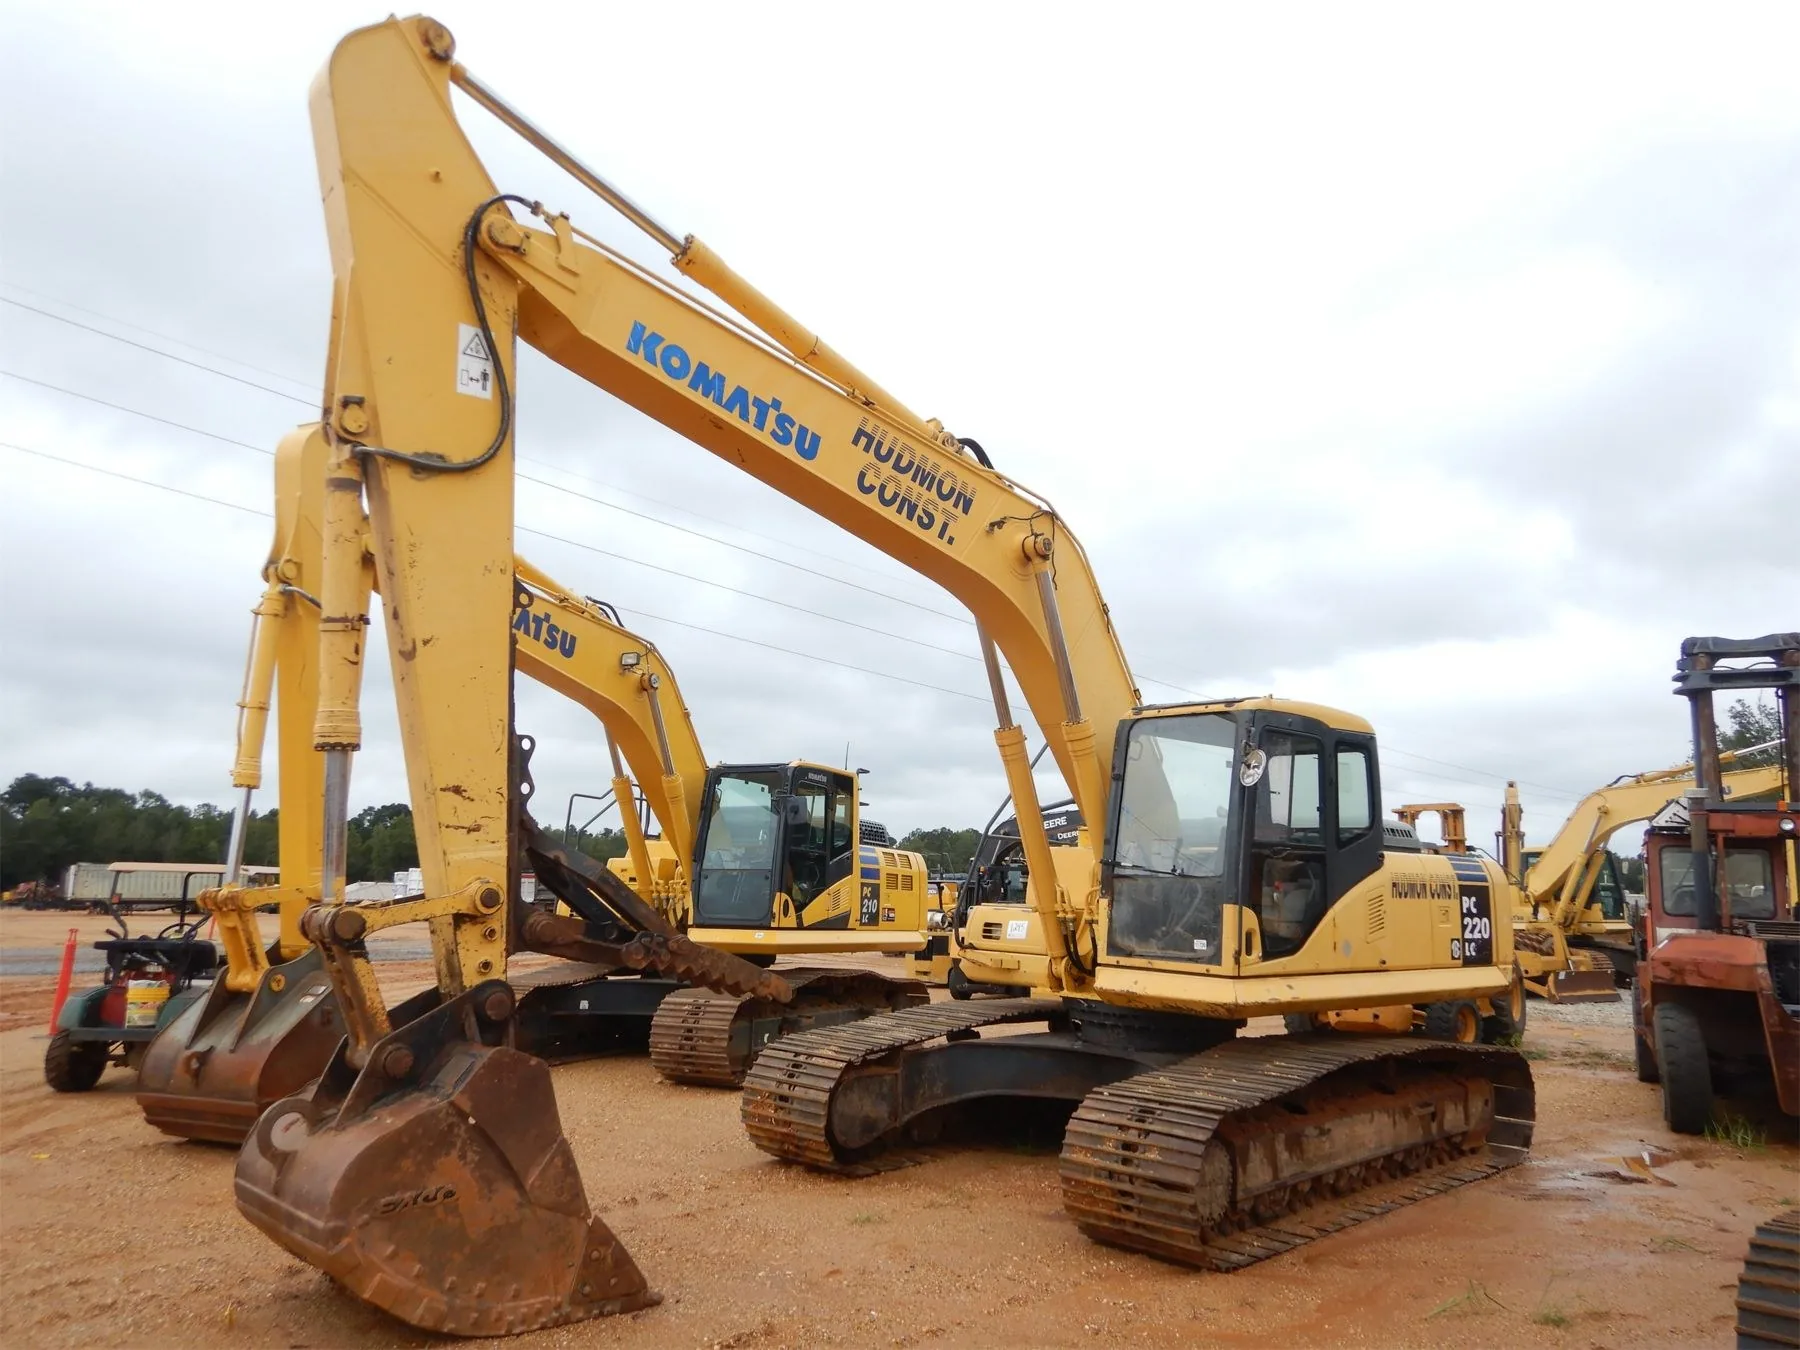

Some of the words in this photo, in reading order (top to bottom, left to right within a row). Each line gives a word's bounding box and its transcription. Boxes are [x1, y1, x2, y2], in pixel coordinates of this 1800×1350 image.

[626, 320, 821, 461] KOMATSU
[851, 416, 977, 516] HUDMON
[857, 462, 959, 545] CONST.
[862, 886, 871, 897] PC
[862, 899, 878, 913] 210
[1462, 896, 1477, 914] PC
[1463, 917, 1490, 939] 220
[1465, 942, 1477, 956] LC
